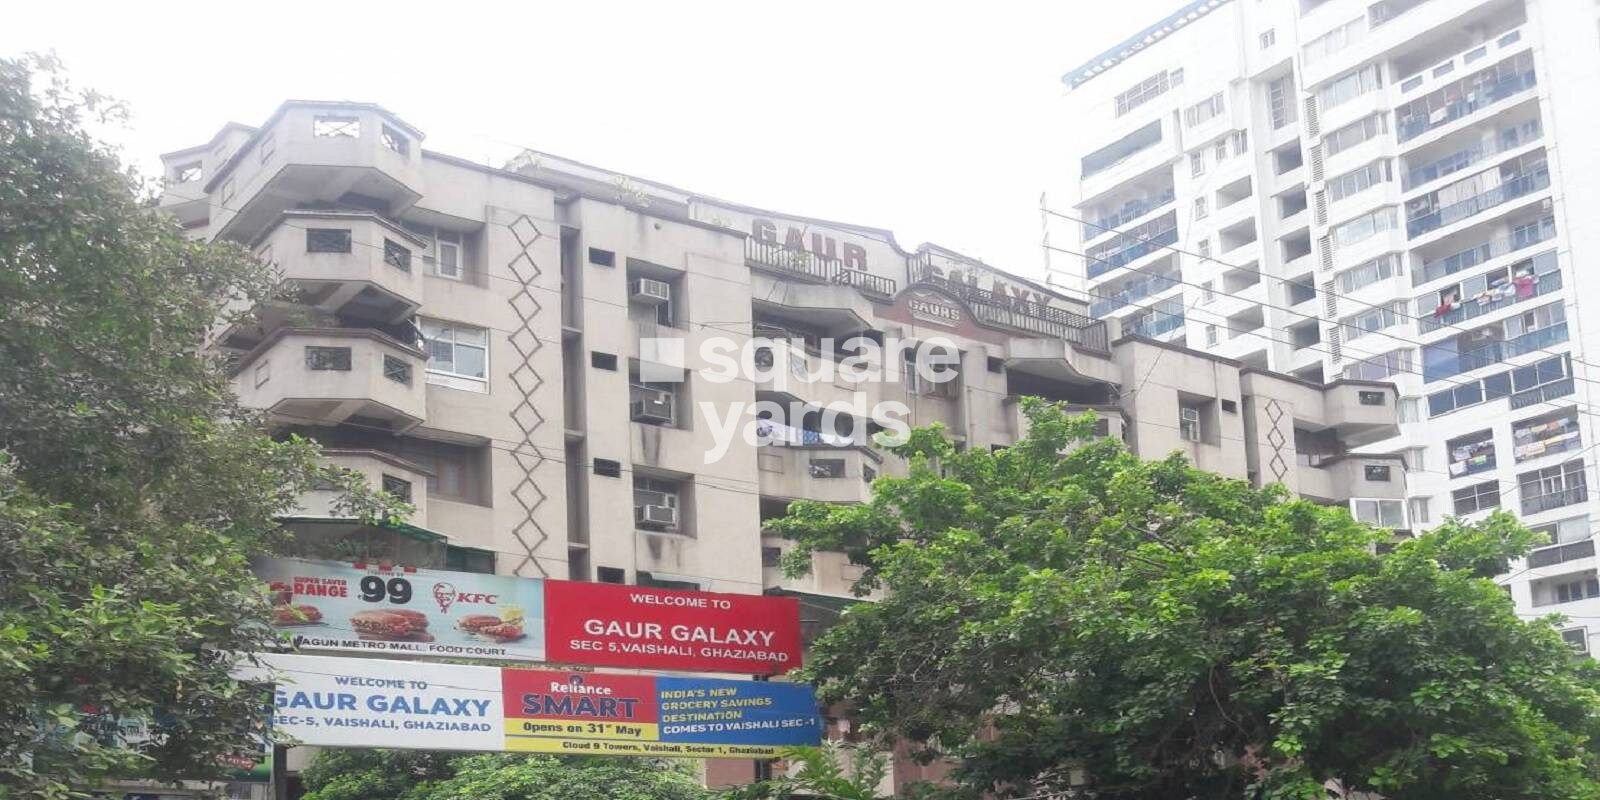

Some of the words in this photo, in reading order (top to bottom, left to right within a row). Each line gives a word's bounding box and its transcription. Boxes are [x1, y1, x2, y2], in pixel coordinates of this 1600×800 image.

[752, 219, 868, 271] GAUR
[909, 299, 960, 320] GAURS
[293, 582, 348, 598] RANGE
[457, 592, 499, 605] KFC
[630, 592, 707, 608] WELCOME
[711, 599, 731, 609] TO
[584, 619, 662, 639] GAUR
[671, 624, 775, 647] GALAXY
[342, 639, 386, 649] METRO
[429, 644, 463, 653] FOOD
[466, 646, 507, 655] COURT
[570, 639, 603, 651] SEC
[701, 647, 788, 662] GHAZIABAD
[335, 676, 405, 690] WELCOME
[410, 680, 428, 690] TO
[550, 681, 612, 695] Reliance
[661, 688, 705, 699] INDIA'S
[710, 687, 737, 697] NEW
[366, 693, 492, 717] GALAXY
[522, 693, 640, 718] SMART
[662, 700, 718, 711] GROCERY
[721, 697, 772, 708] SAVINGS
[662, 710, 742, 722] DESTINATION
[323, 717, 399, 730] VAISHALI,
[403, 720, 491, 732] GHAZIABAD
[523, 721, 565, 733] Opens
[567, 725, 583, 733] on
[615, 725, 642, 737] May
[663, 724, 706, 734] COMES
[708, 723, 724, 732] TO
[726, 720, 780, 731] VAISHALI
[781, 719, 803, 728] SEC
[562, 741, 591, 749] Cloud
[603, 743, 642, 752] Towers,
[686, 745, 714, 753] Sector
[729, 746, 775, 755] Ghaziabad
